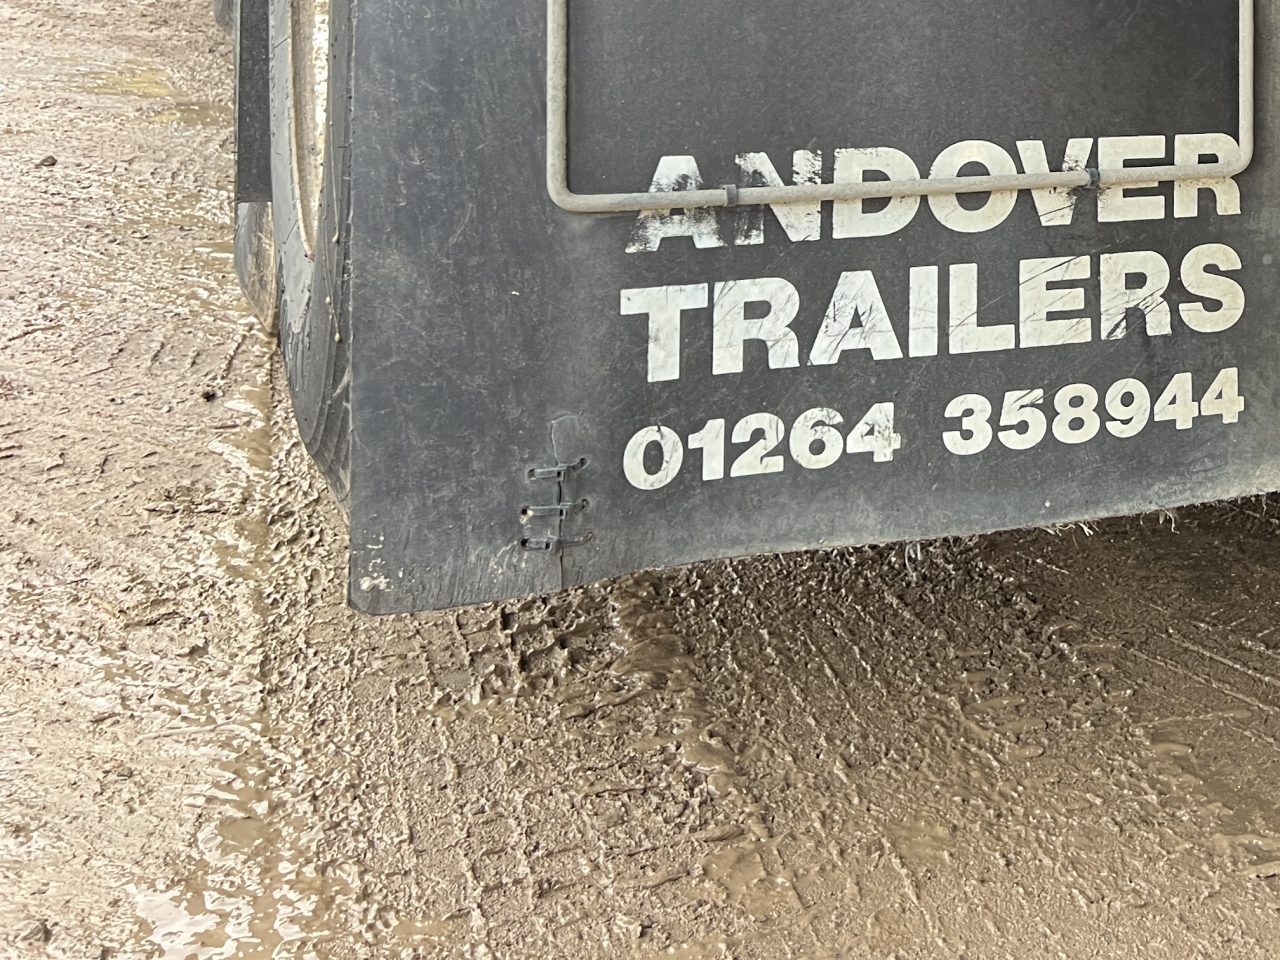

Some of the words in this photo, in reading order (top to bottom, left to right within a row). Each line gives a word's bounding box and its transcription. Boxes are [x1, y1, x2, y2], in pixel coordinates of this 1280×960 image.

[624, 133, 1241, 253] ANDOVER
[620, 243, 1246, 382] TRAILERS
[622, 402, 902, 490] 01264
[942, 367, 1245, 456] 358944
